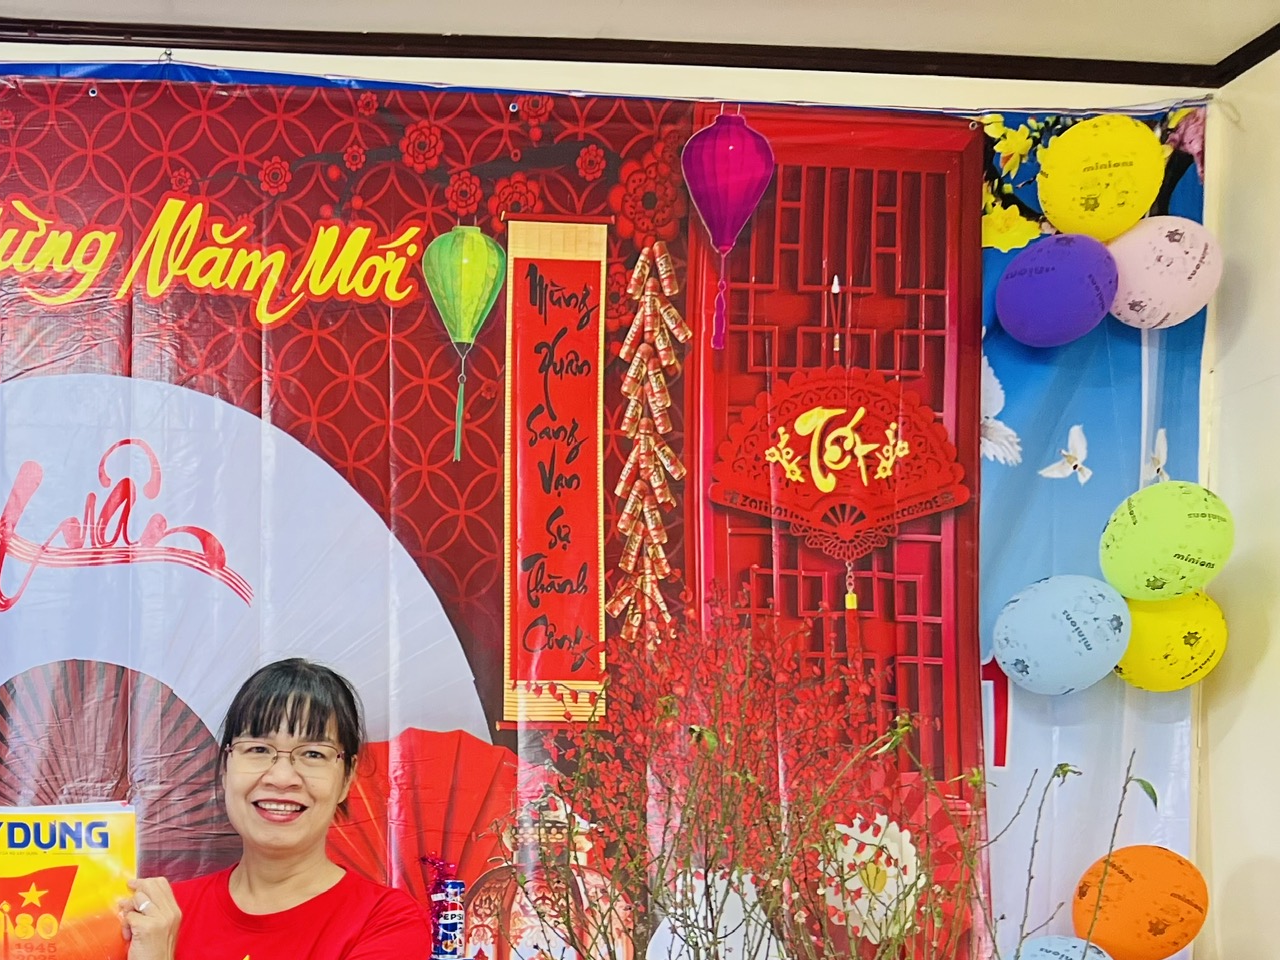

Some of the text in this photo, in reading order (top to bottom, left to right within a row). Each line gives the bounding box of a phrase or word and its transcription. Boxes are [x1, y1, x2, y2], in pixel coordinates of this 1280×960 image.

[117, 198, 305, 325] Năm
[291, 223, 421, 302] Mới
[526, 403, 589, 464] Sang
[794, 406, 880, 493] Tết
[1173, 553, 1216, 569] minions
[1062, 609, 1093, 651] minions
